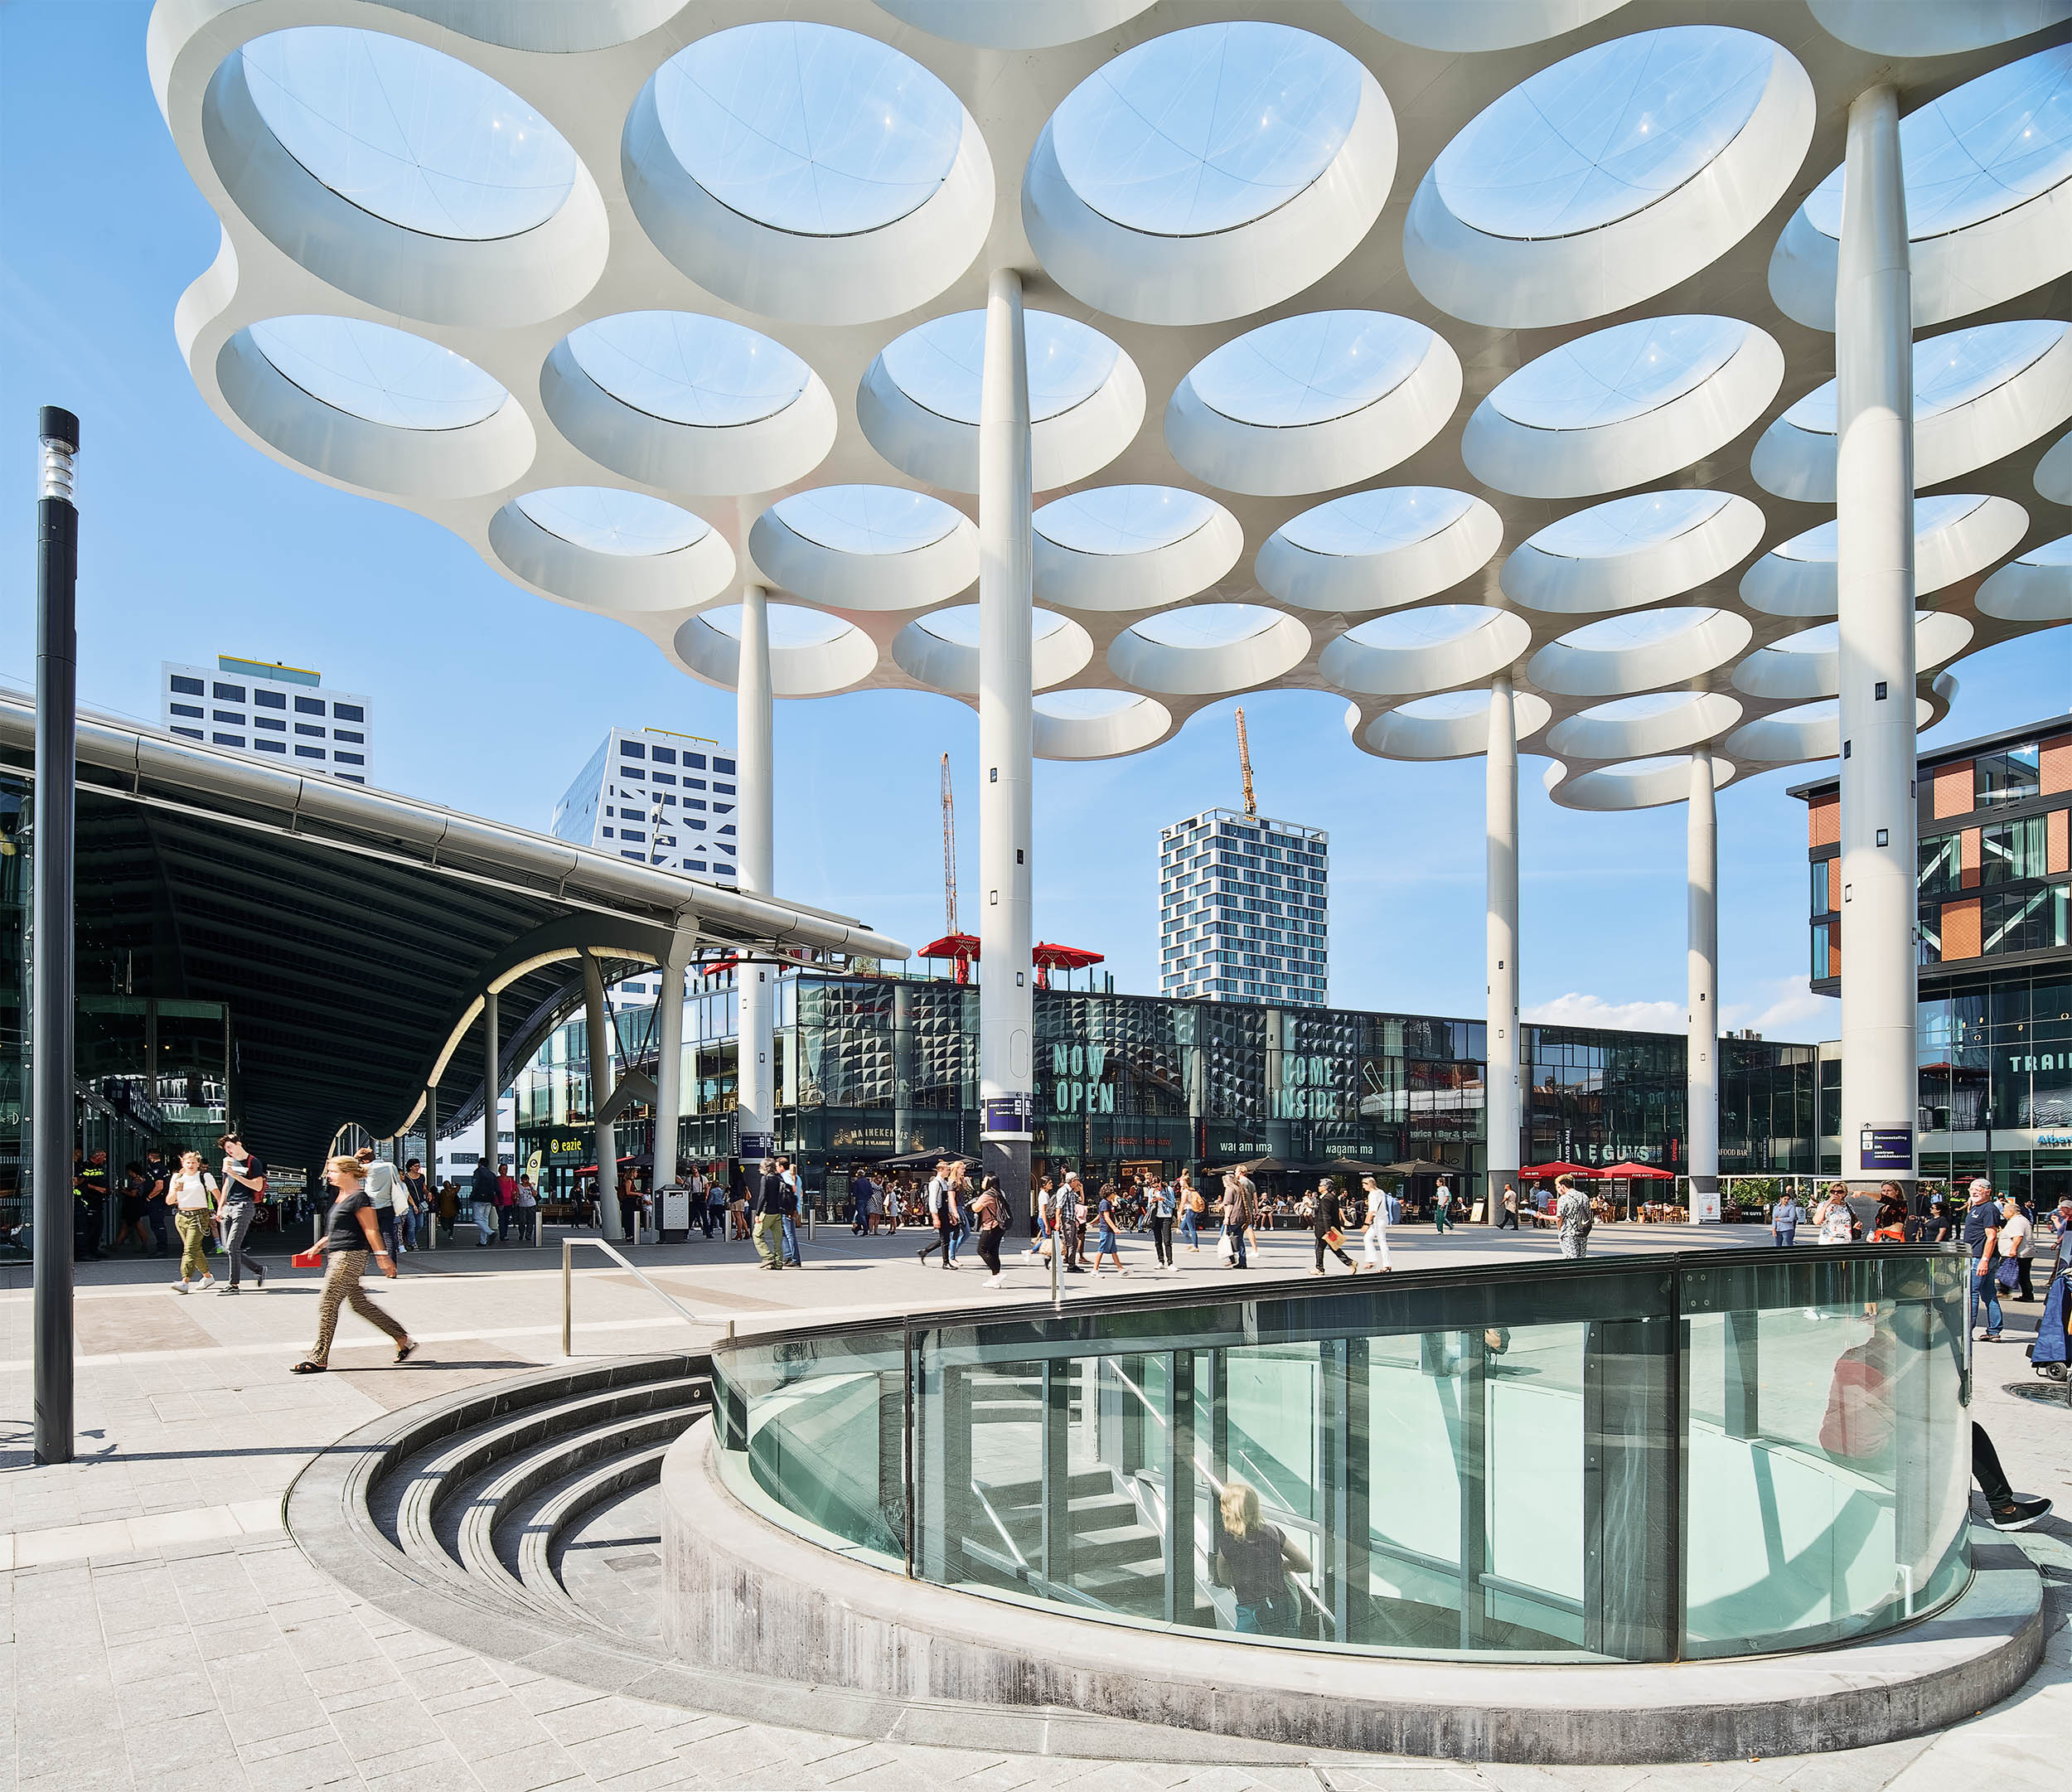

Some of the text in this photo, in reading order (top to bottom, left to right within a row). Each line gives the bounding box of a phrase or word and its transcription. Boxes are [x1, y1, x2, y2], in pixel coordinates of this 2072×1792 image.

[1053, 1044, 1105, 1077] NOW
[1281, 1056, 1334, 1087] COME
[1056, 1082, 1114, 1114] OPEN
[1273, 1088, 1338, 1120] INSIDE
[561, 1137, 582, 1152] eazie
[1325, 1142, 1373, 1155] wagamma
[1602, 1145, 1650, 1161] GUYS
[1737, 1148, 1748, 1157] BAR
